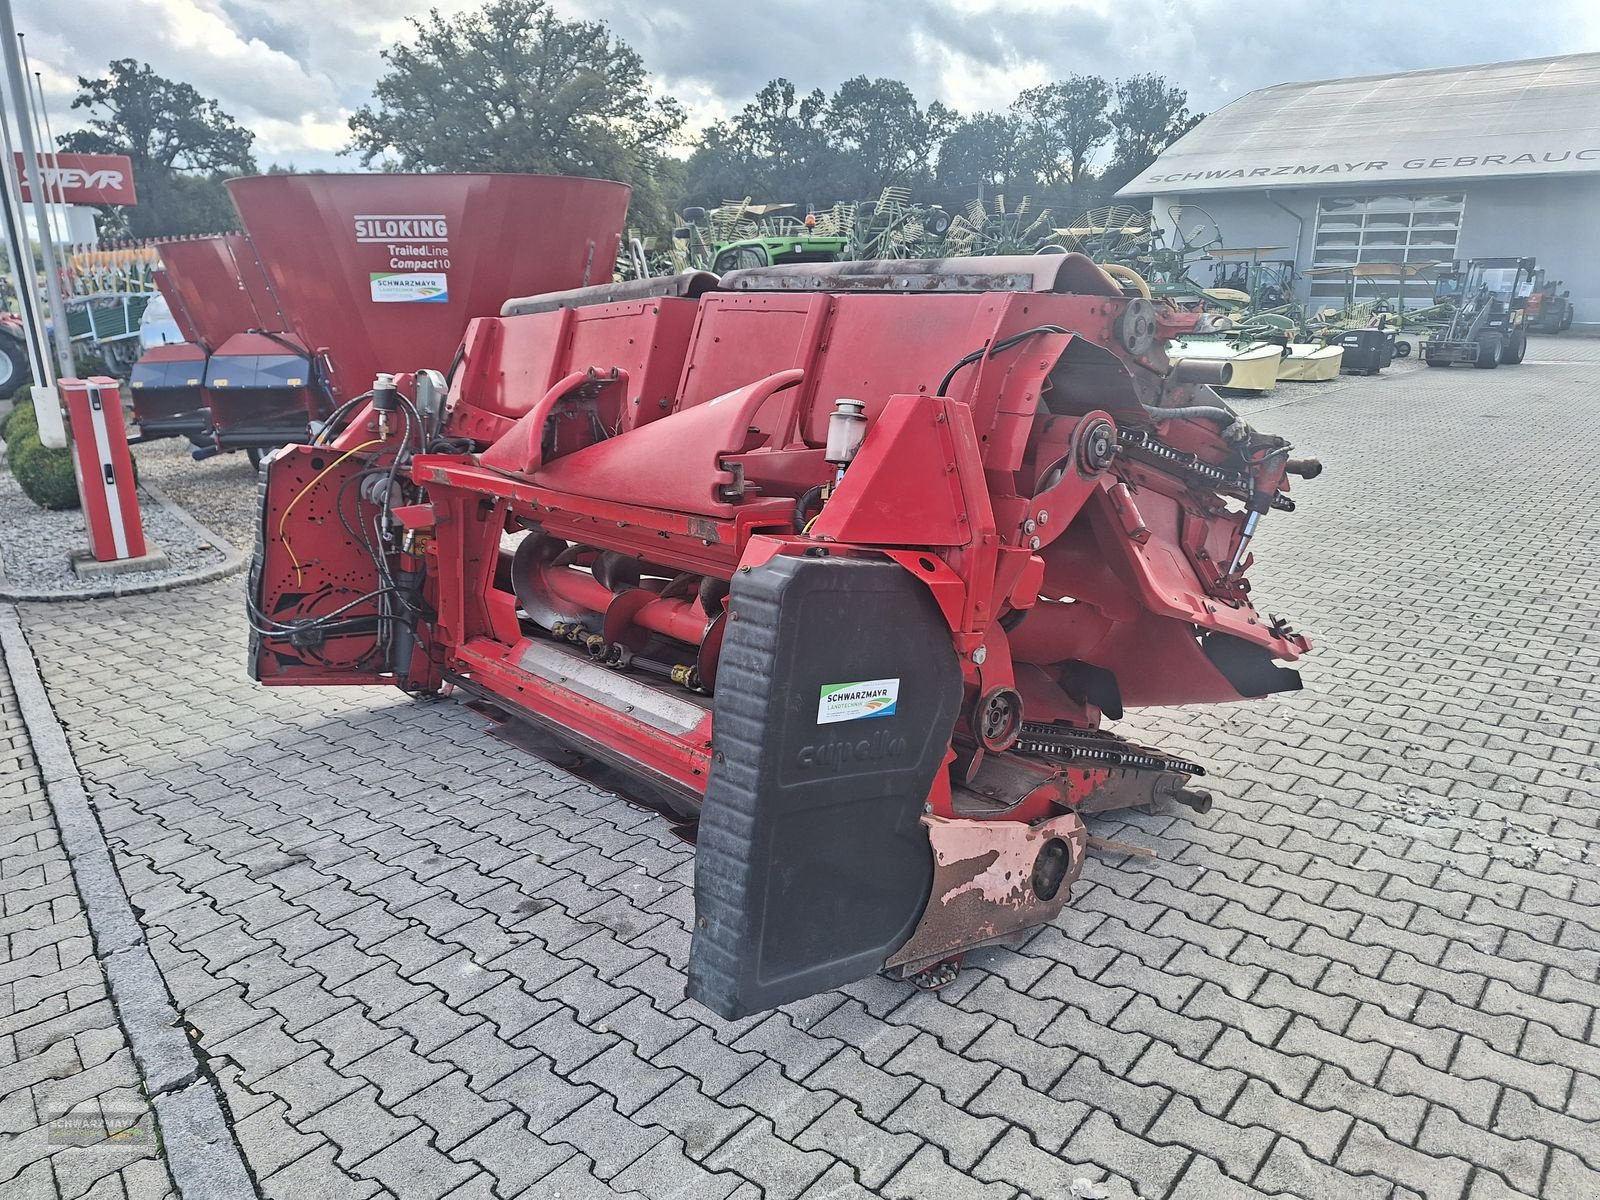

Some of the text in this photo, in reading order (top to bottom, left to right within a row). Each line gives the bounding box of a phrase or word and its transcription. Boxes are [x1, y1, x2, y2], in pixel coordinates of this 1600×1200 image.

[1147, 149, 1600, 184] SCHWARZMAYR GEBRAUC
[354, 220, 448, 237] SILOKING
[387, 244, 449, 256] TrailedLine
[827, 689, 888, 703] SCHWARZMAYR
[826, 702, 863, 711] LANDTECHNIK
